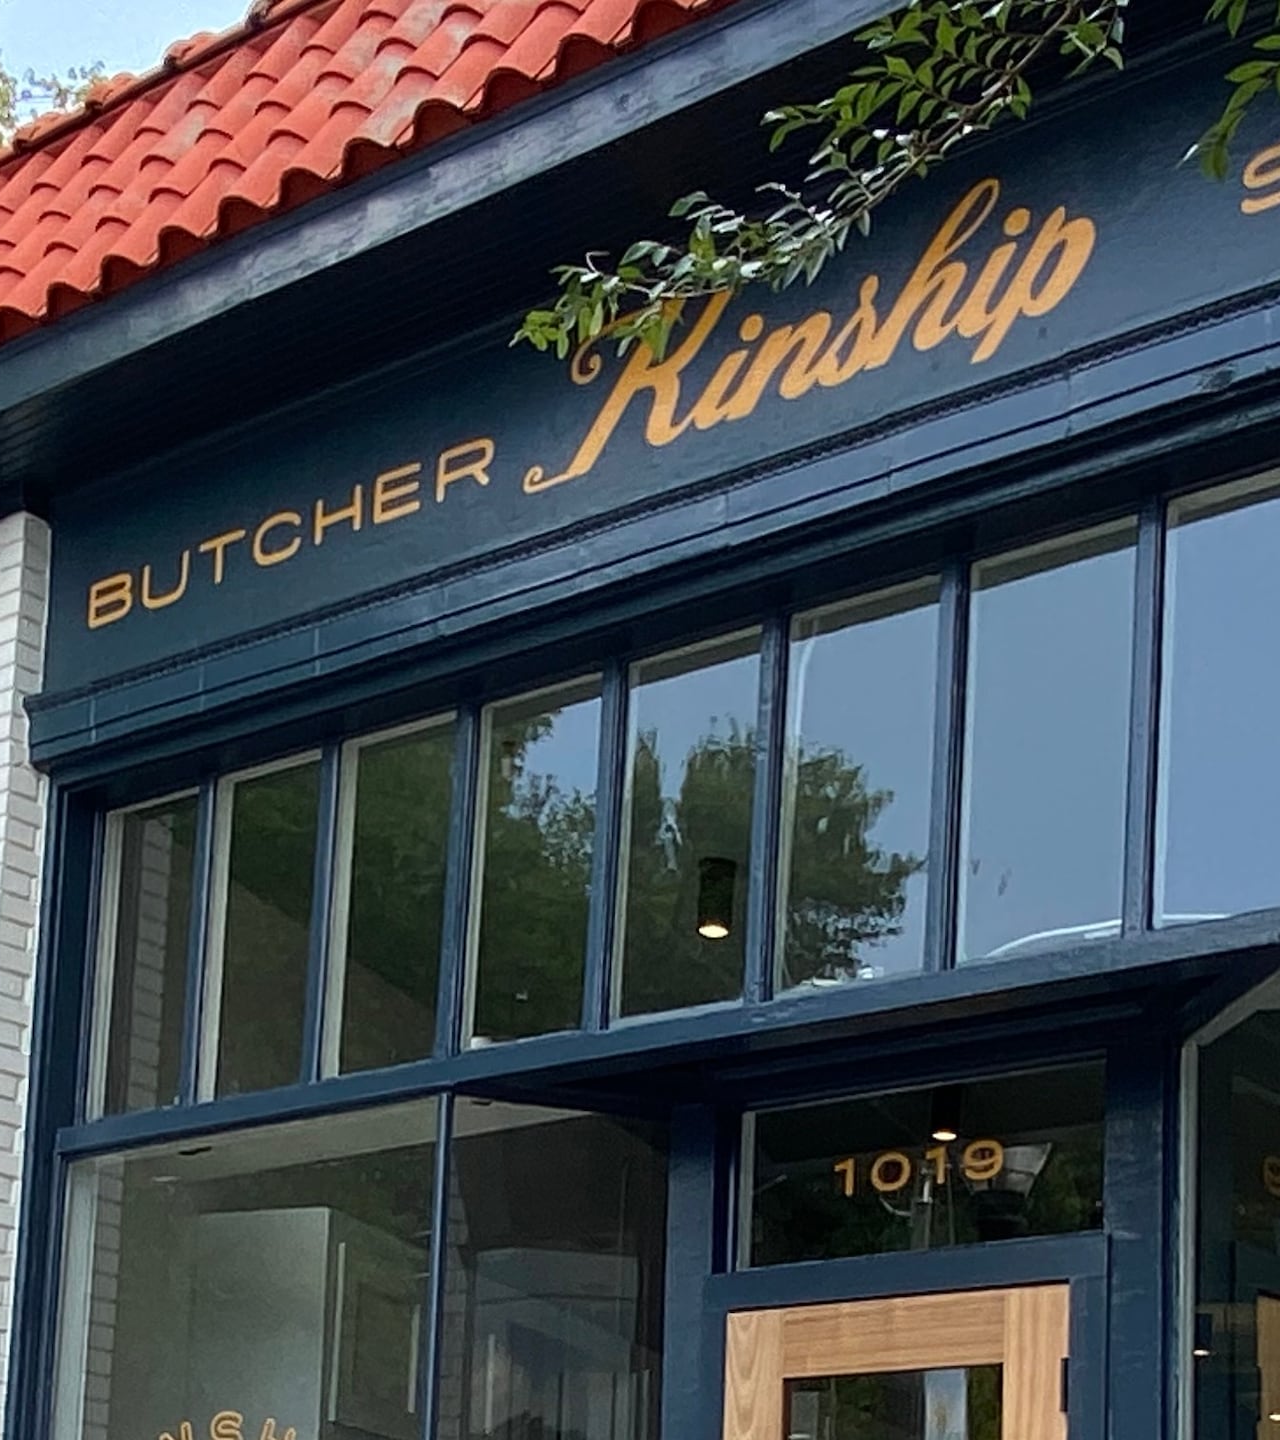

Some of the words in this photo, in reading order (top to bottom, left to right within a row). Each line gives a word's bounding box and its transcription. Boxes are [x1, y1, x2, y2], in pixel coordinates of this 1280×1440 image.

[86, 437, 495, 629] BUTCHER
[523, 177, 1097, 495] Kinship
[834, 1138, 1005, 1198] 1019
